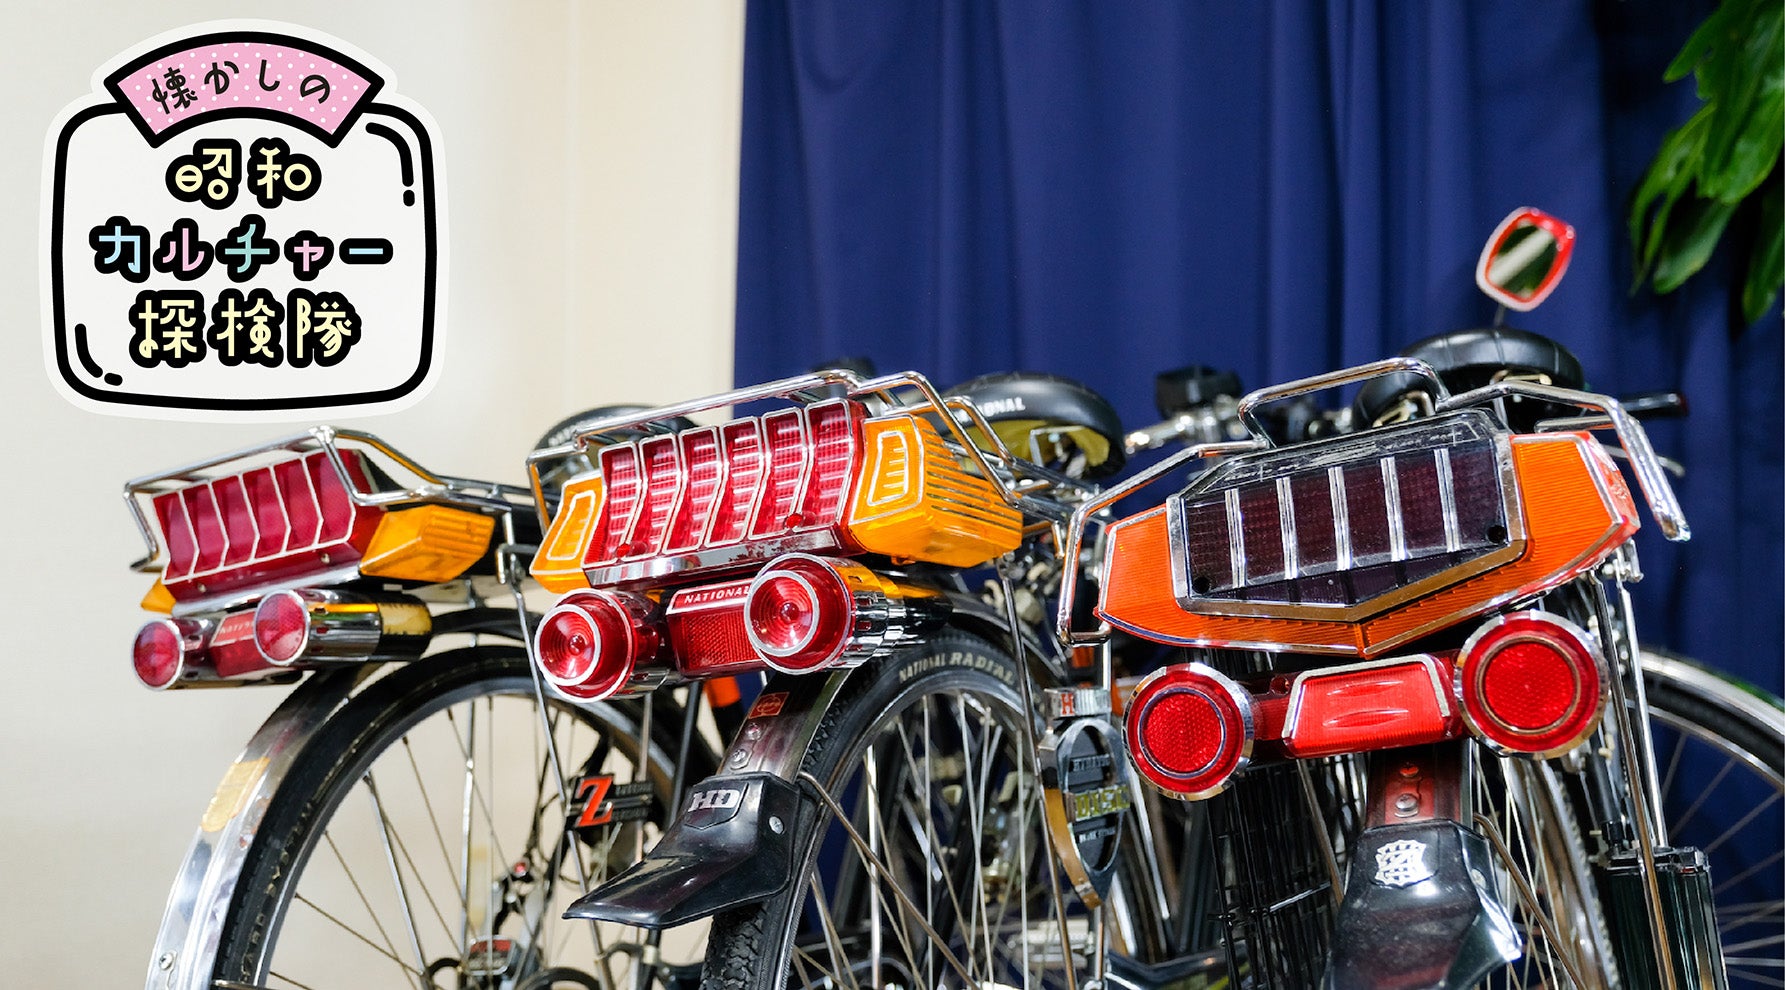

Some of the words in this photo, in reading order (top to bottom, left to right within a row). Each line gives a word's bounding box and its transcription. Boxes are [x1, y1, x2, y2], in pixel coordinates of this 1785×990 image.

[684, 586, 751, 604] NATIONAL
[899, 653, 946, 683] NATIONAL
[948, 652, 1016, 686] RADIAL
[575, 775, 613, 828] Z
[687, 789, 740, 812] HD
